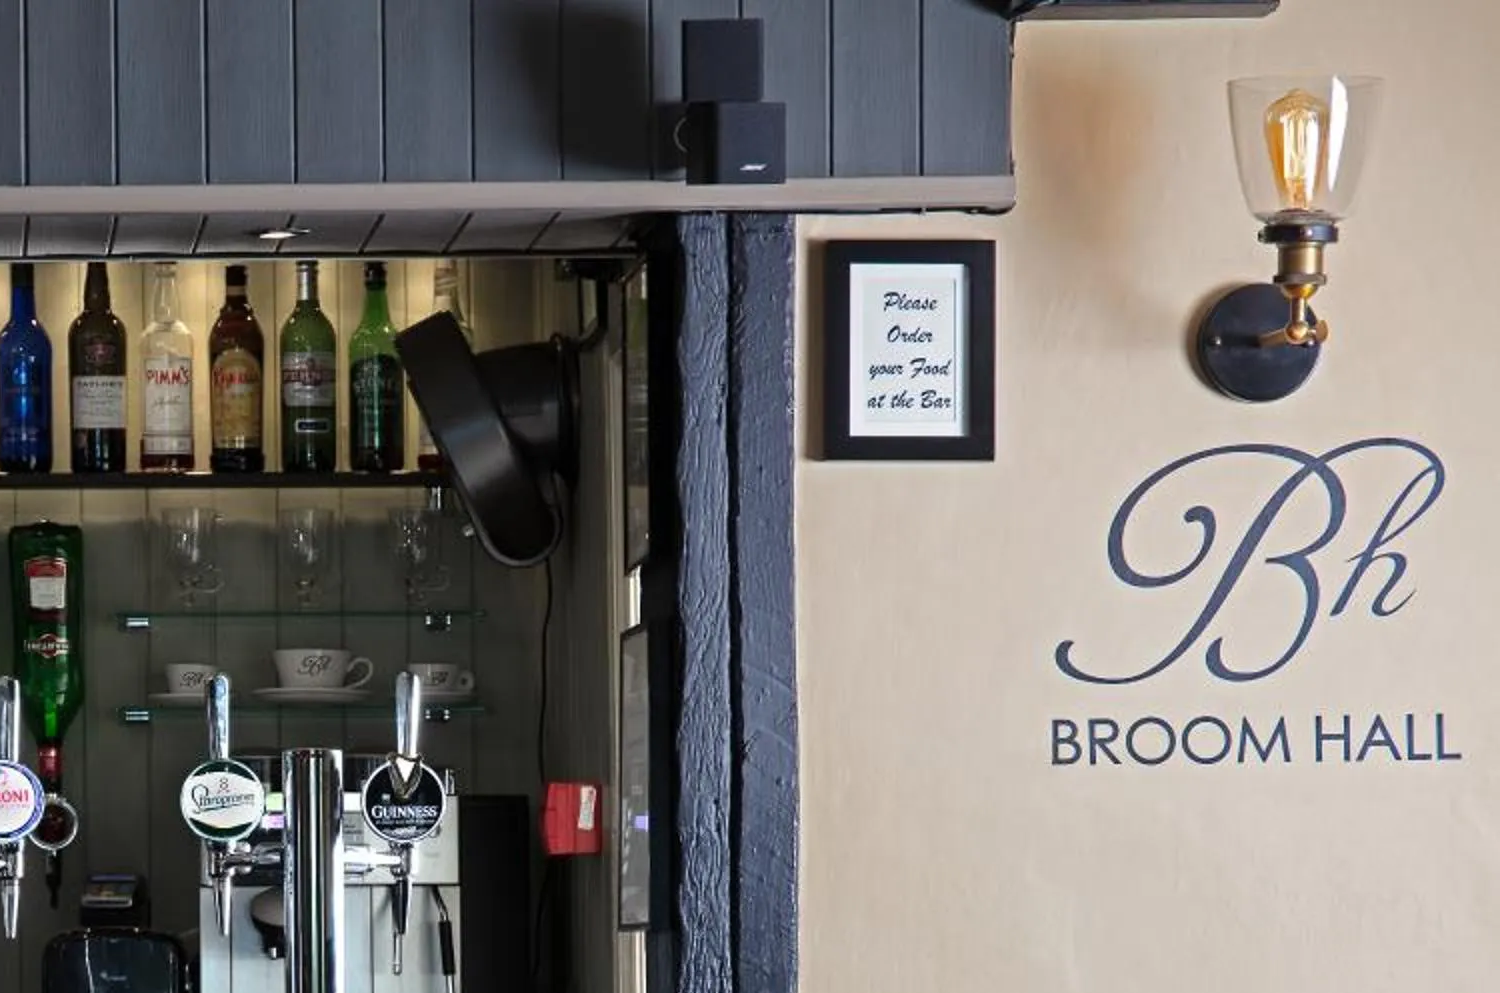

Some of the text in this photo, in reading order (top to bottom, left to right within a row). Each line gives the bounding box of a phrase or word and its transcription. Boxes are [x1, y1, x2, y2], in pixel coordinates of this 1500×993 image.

[884, 291, 938, 311] Please
[887, 325, 933, 343] Order
[147, 366, 190, 386] PIMM'S
[868, 357, 952, 380] your Food
[867, 389, 951, 409] at the Bar
[1055, 437, 1446, 685] Bh
[1051, 713, 1463, 766] BROOM HALL
[371, 804, 438, 820] GUINNESS
